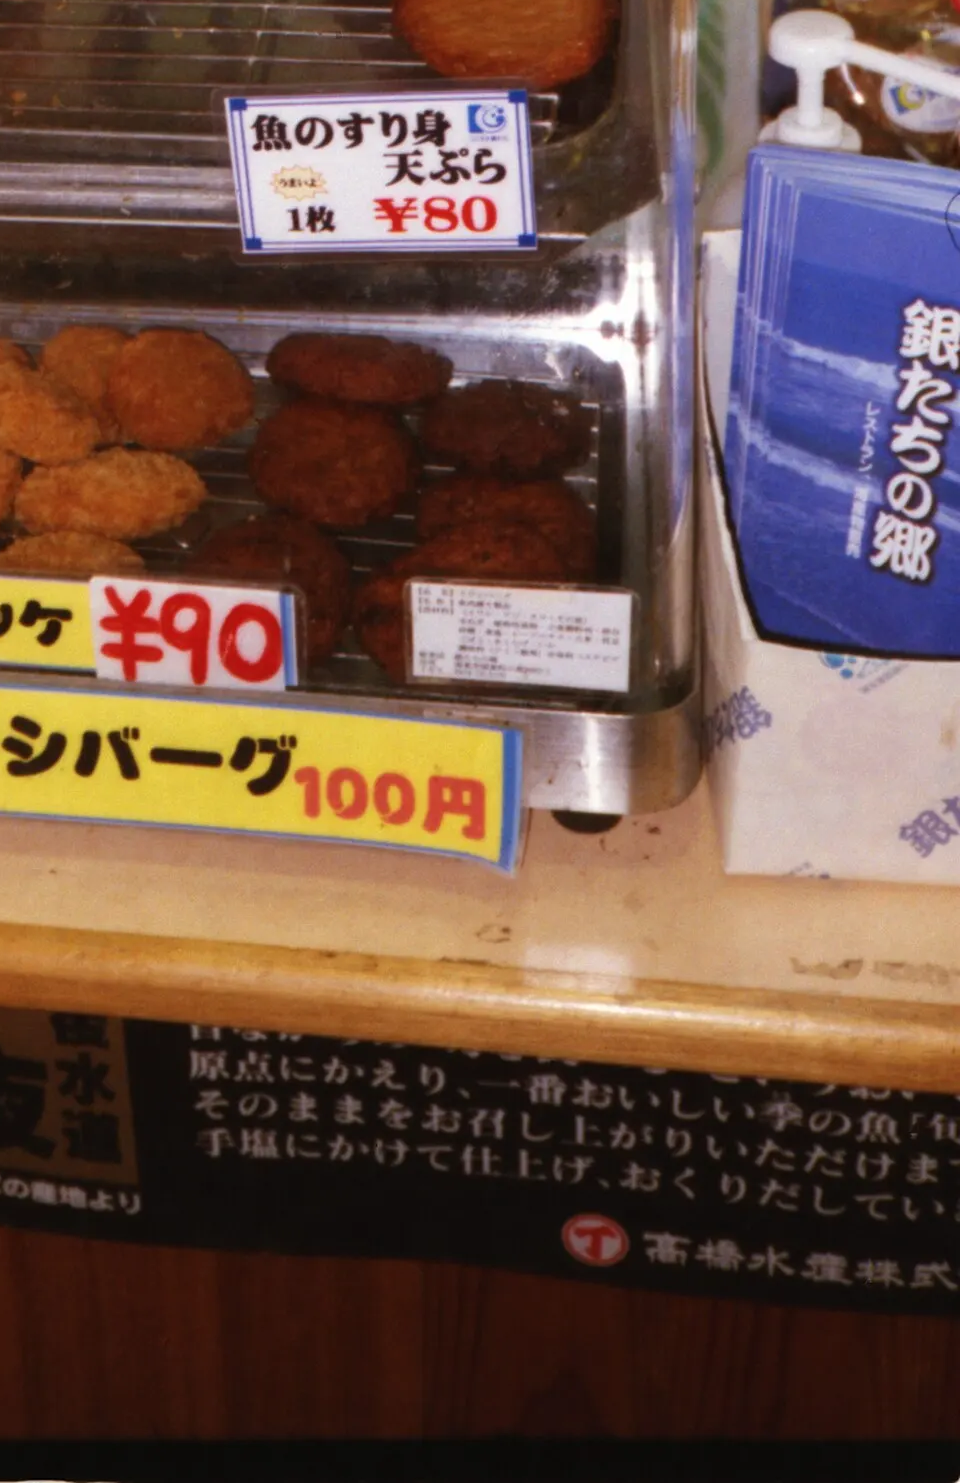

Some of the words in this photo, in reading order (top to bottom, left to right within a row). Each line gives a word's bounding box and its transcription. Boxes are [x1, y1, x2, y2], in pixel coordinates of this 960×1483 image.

[251, 109, 451, 151] 魚のすり身
[383, 148, 507, 186] 天ぷら
[288, 205, 336, 233] 1枚
[372, 196, 498, 233] ¥80
[871, 298, 960, 582] 銀たちの郷
[99, 585, 286, 685] ¥90
[294, 764, 486, 841] 100円
[194, 1089, 960, 1185] そのままをお召し上がりいただけま
[196, 1126, 960, 1223] 手塩にかけて仕上げ、おくりだしてい
